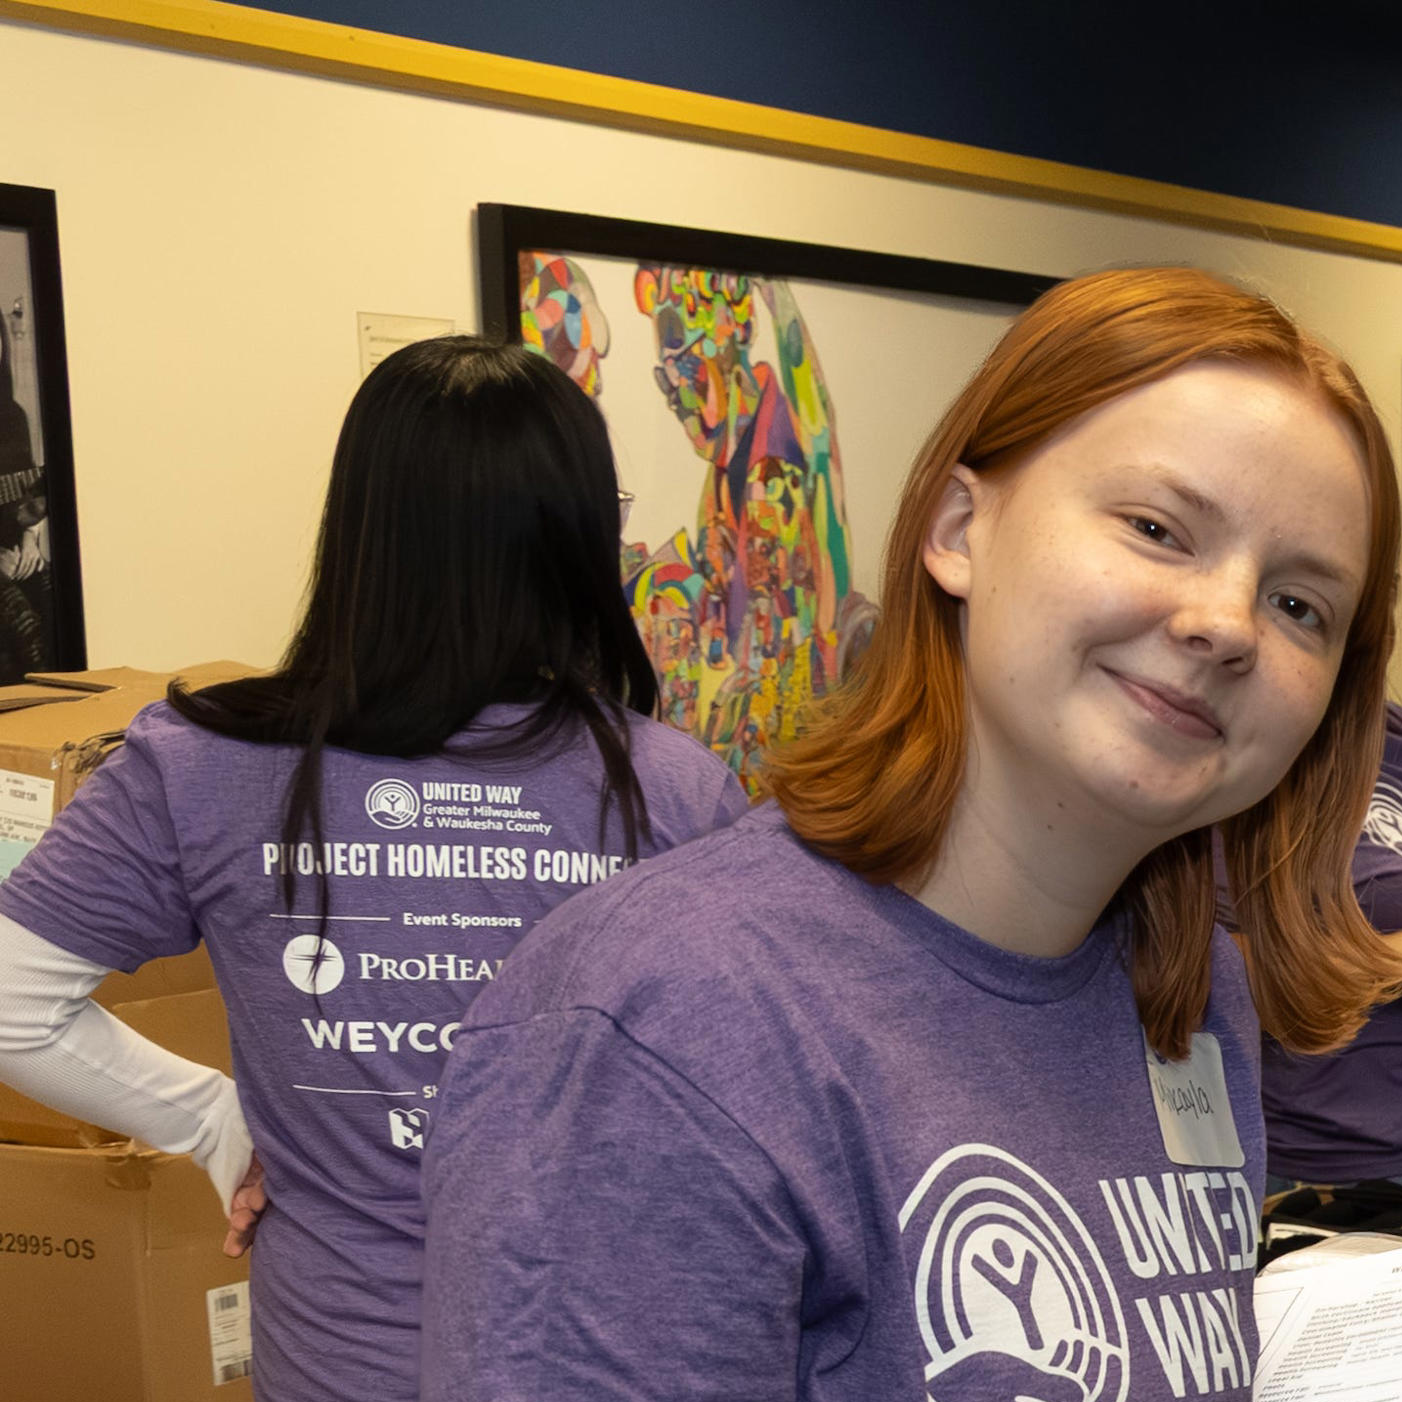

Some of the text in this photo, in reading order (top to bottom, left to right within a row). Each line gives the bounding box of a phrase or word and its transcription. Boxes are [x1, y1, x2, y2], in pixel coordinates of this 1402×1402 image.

[423, 782, 522, 805] UNITED WAY
[423, 803, 541, 820] Greater Milwaukee
[423, 817, 552, 836] & Waukesha County
[262, 842, 380, 876] POJECT
[387, 843, 527, 881] HOMELESS
[403, 913, 522, 929] Event Sponsors
[0, 1232, 95, 1260] 2995-OS
[1135, 1288, 1251, 1398] WAY
